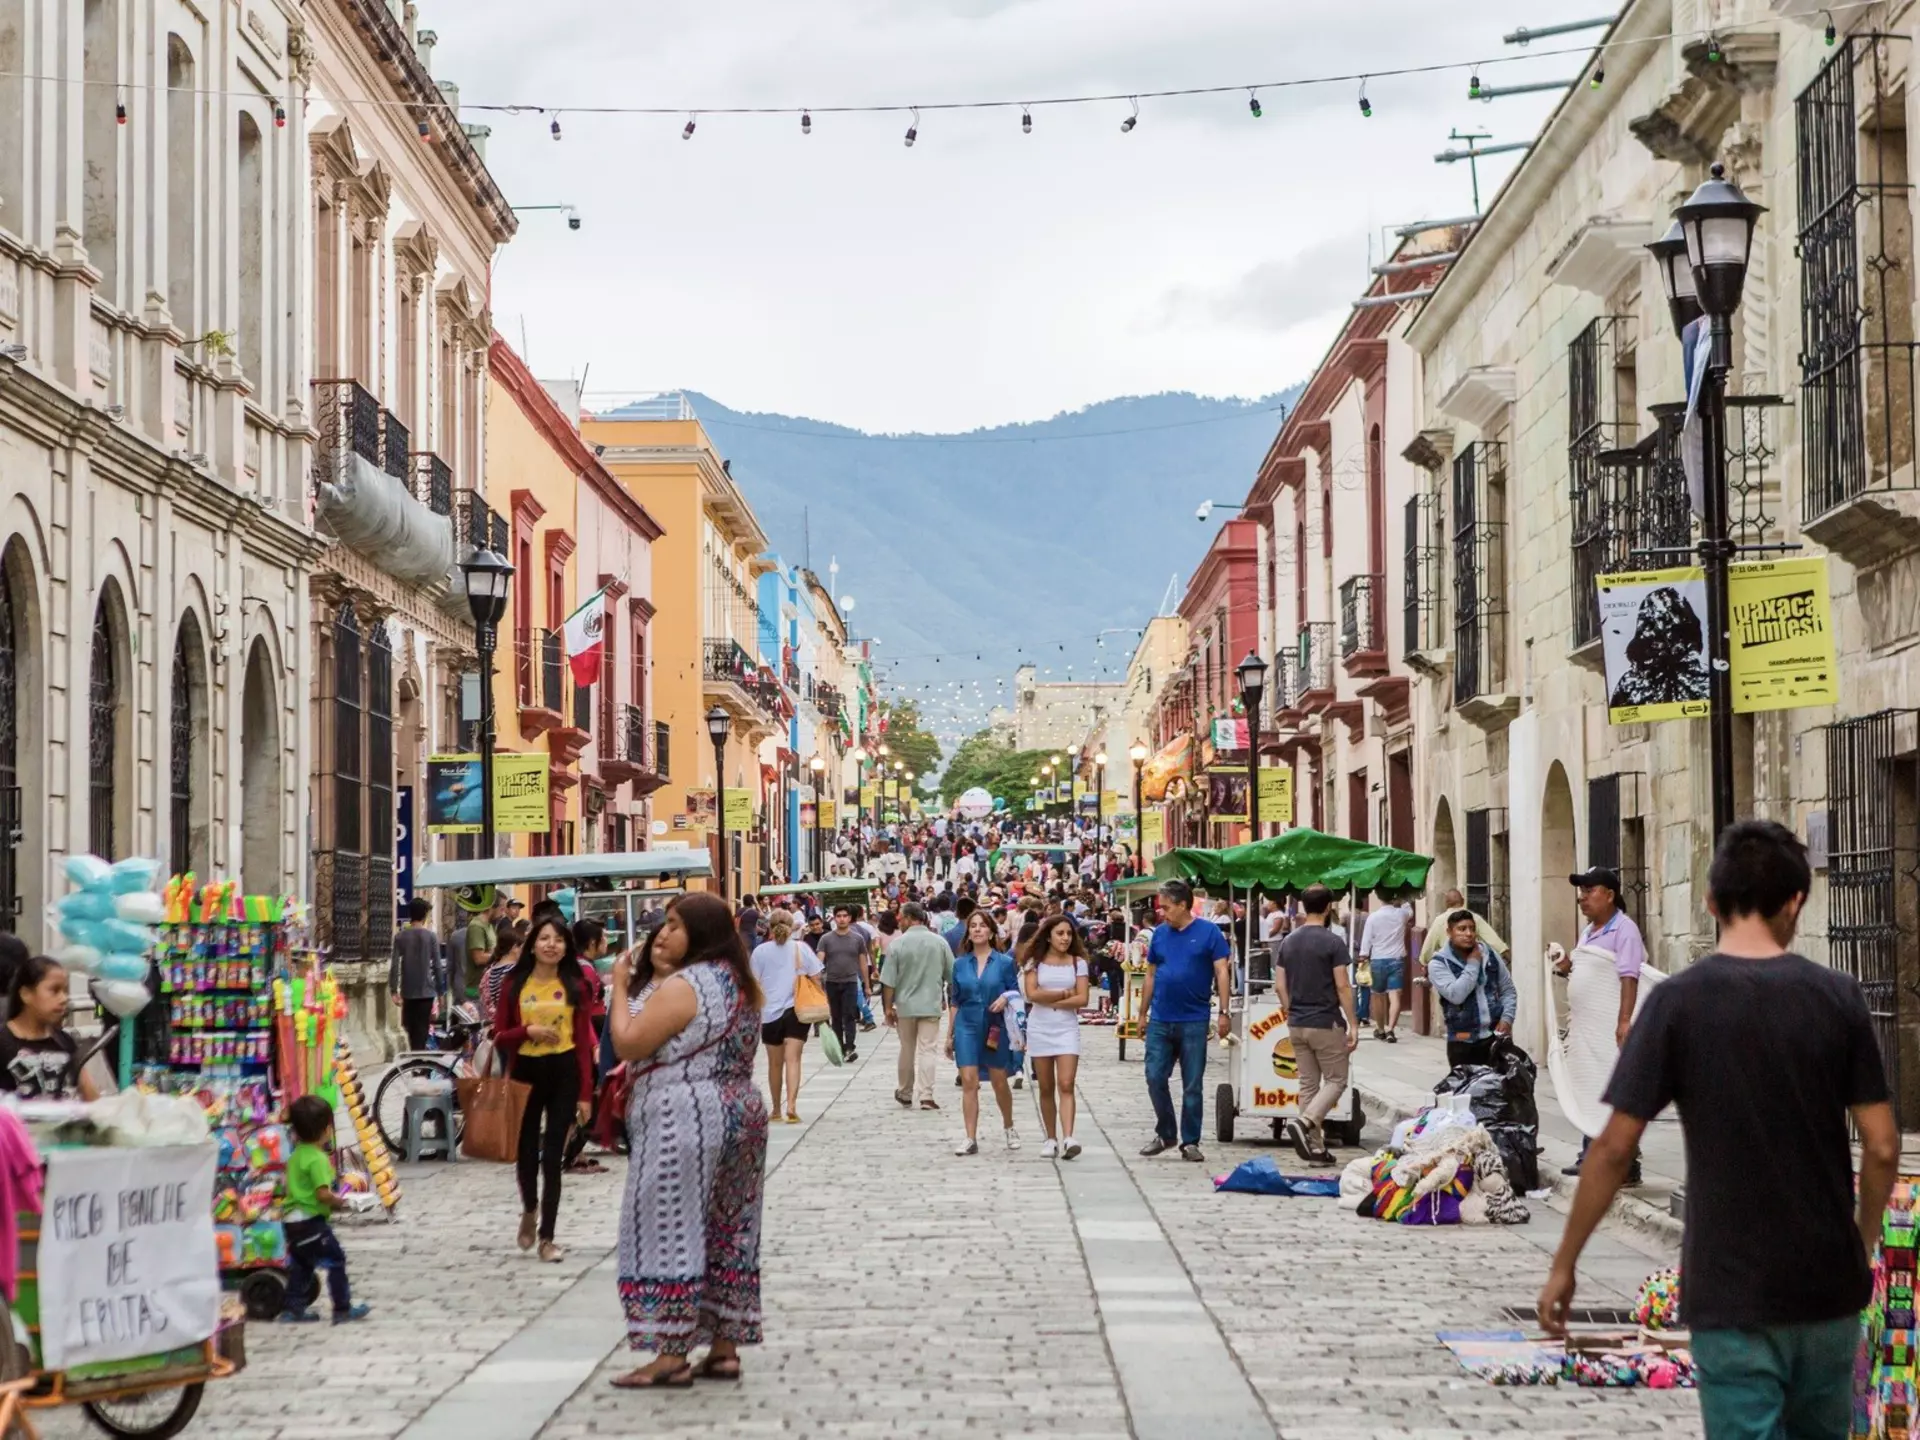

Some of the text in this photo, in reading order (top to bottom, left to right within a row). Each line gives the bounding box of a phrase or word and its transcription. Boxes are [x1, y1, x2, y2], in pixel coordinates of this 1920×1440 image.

[1617, 575, 1637, 583] Forest
[53, 1181, 188, 1241] RICO PONCHE
[107, 1237, 139, 1288] DE
[79, 1291, 169, 1348] FRUTAS
